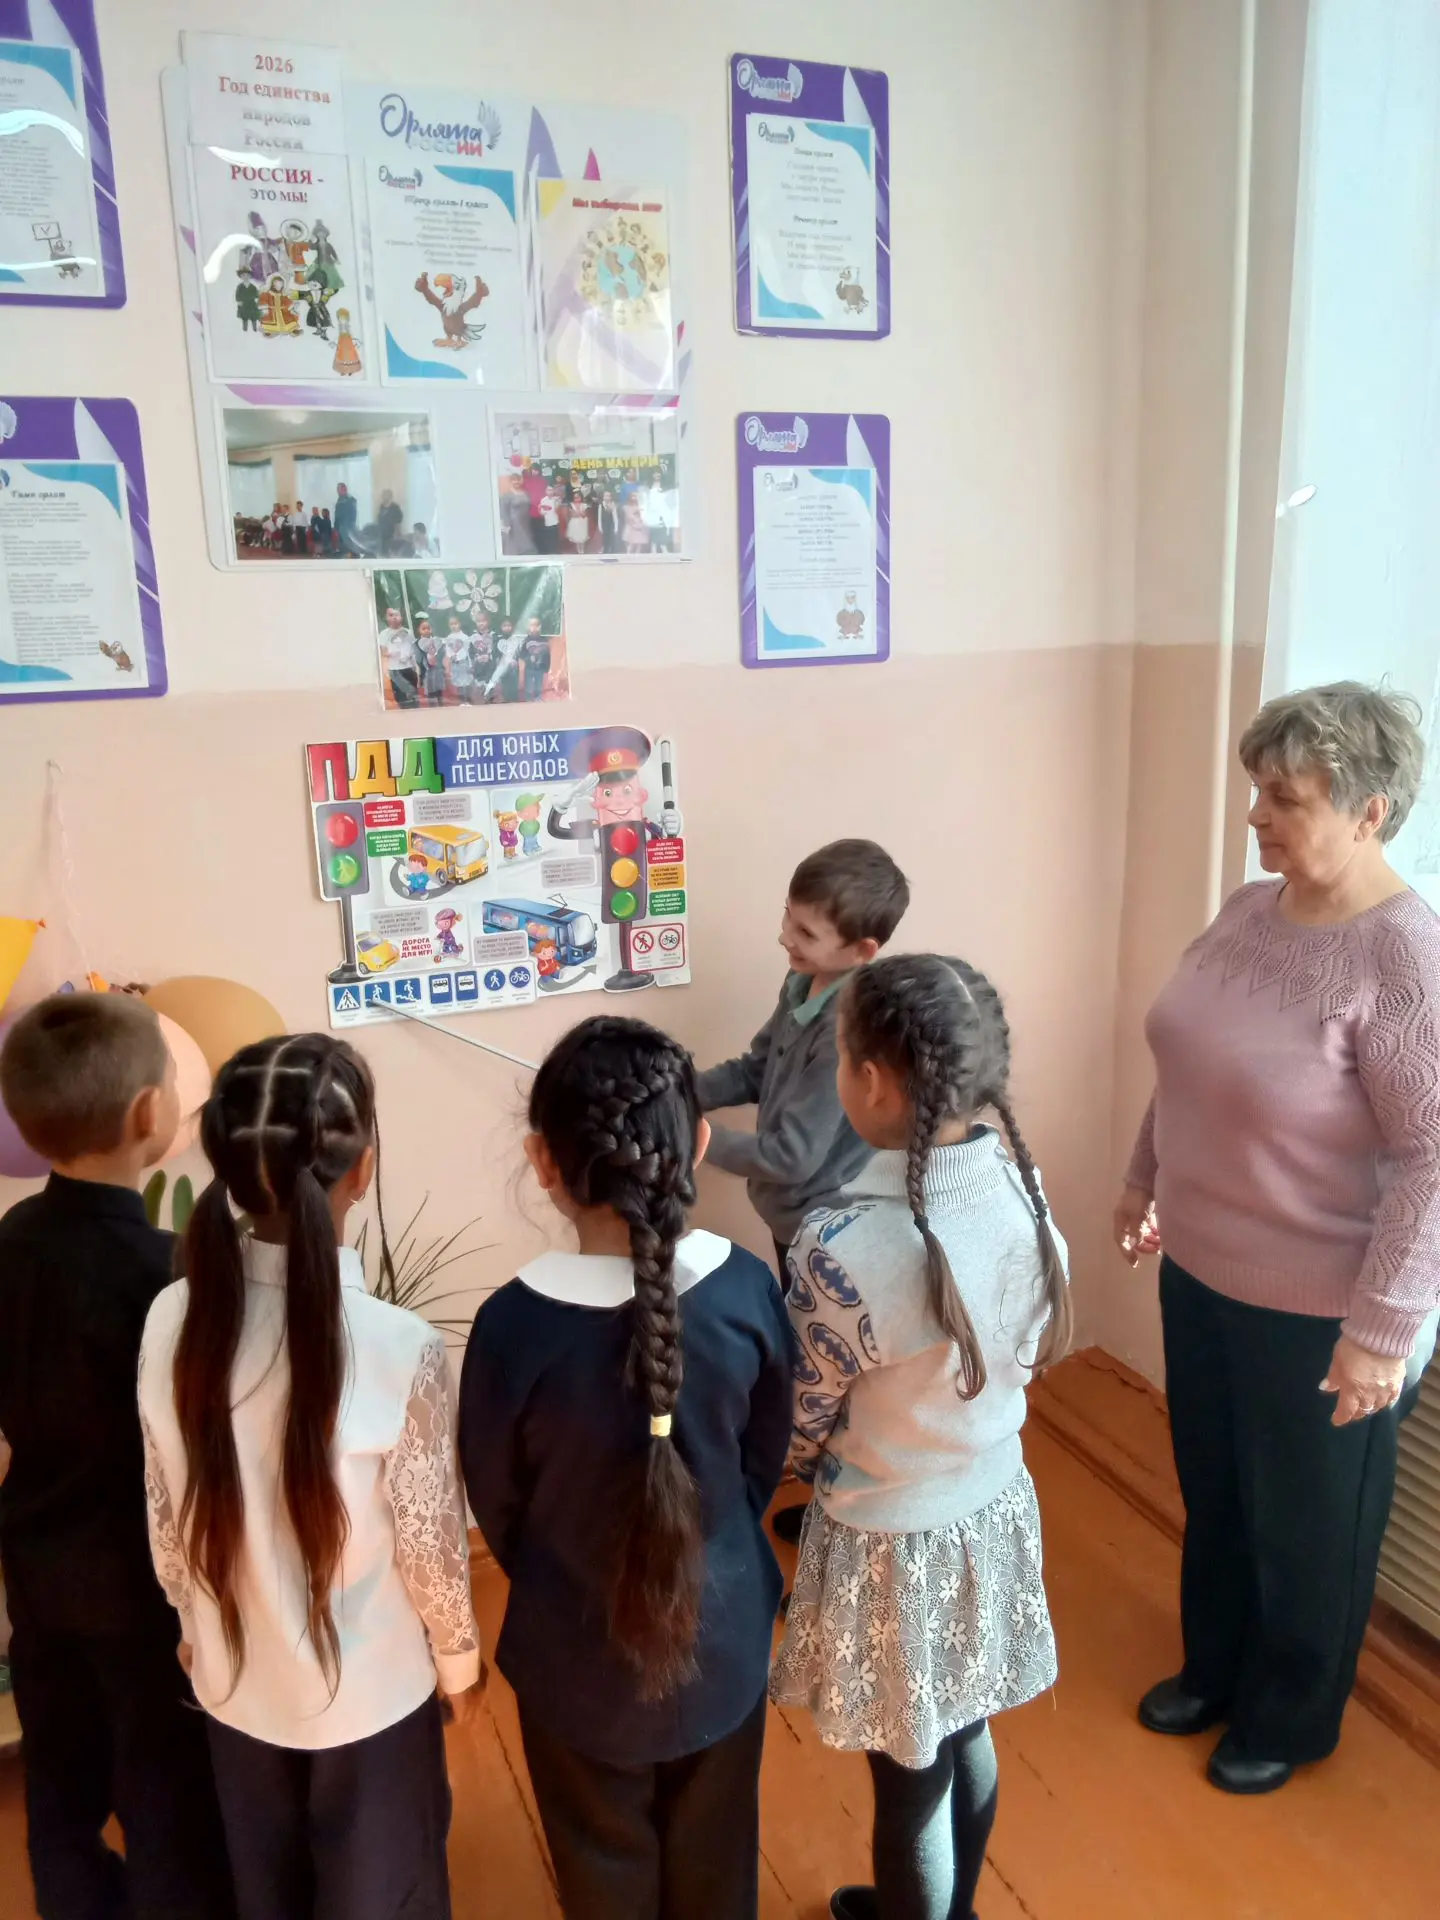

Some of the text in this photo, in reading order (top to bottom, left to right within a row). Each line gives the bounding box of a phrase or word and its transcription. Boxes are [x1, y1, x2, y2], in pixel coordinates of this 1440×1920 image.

[255, 54, 294, 74] 2026
[218, 76, 331, 104] Год единства
[379, 93, 483, 144] Орлята
[230, 164, 313, 185] РОССИЯ
[249, 189, 277, 201] ЭТО
[306, 734, 560, 802] ПДД ДЛЯ ЮНЫХ
[451, 758, 569, 784] ПЕШЕХОДОВ
[402, 938, 430, 946] ДОРОГА
